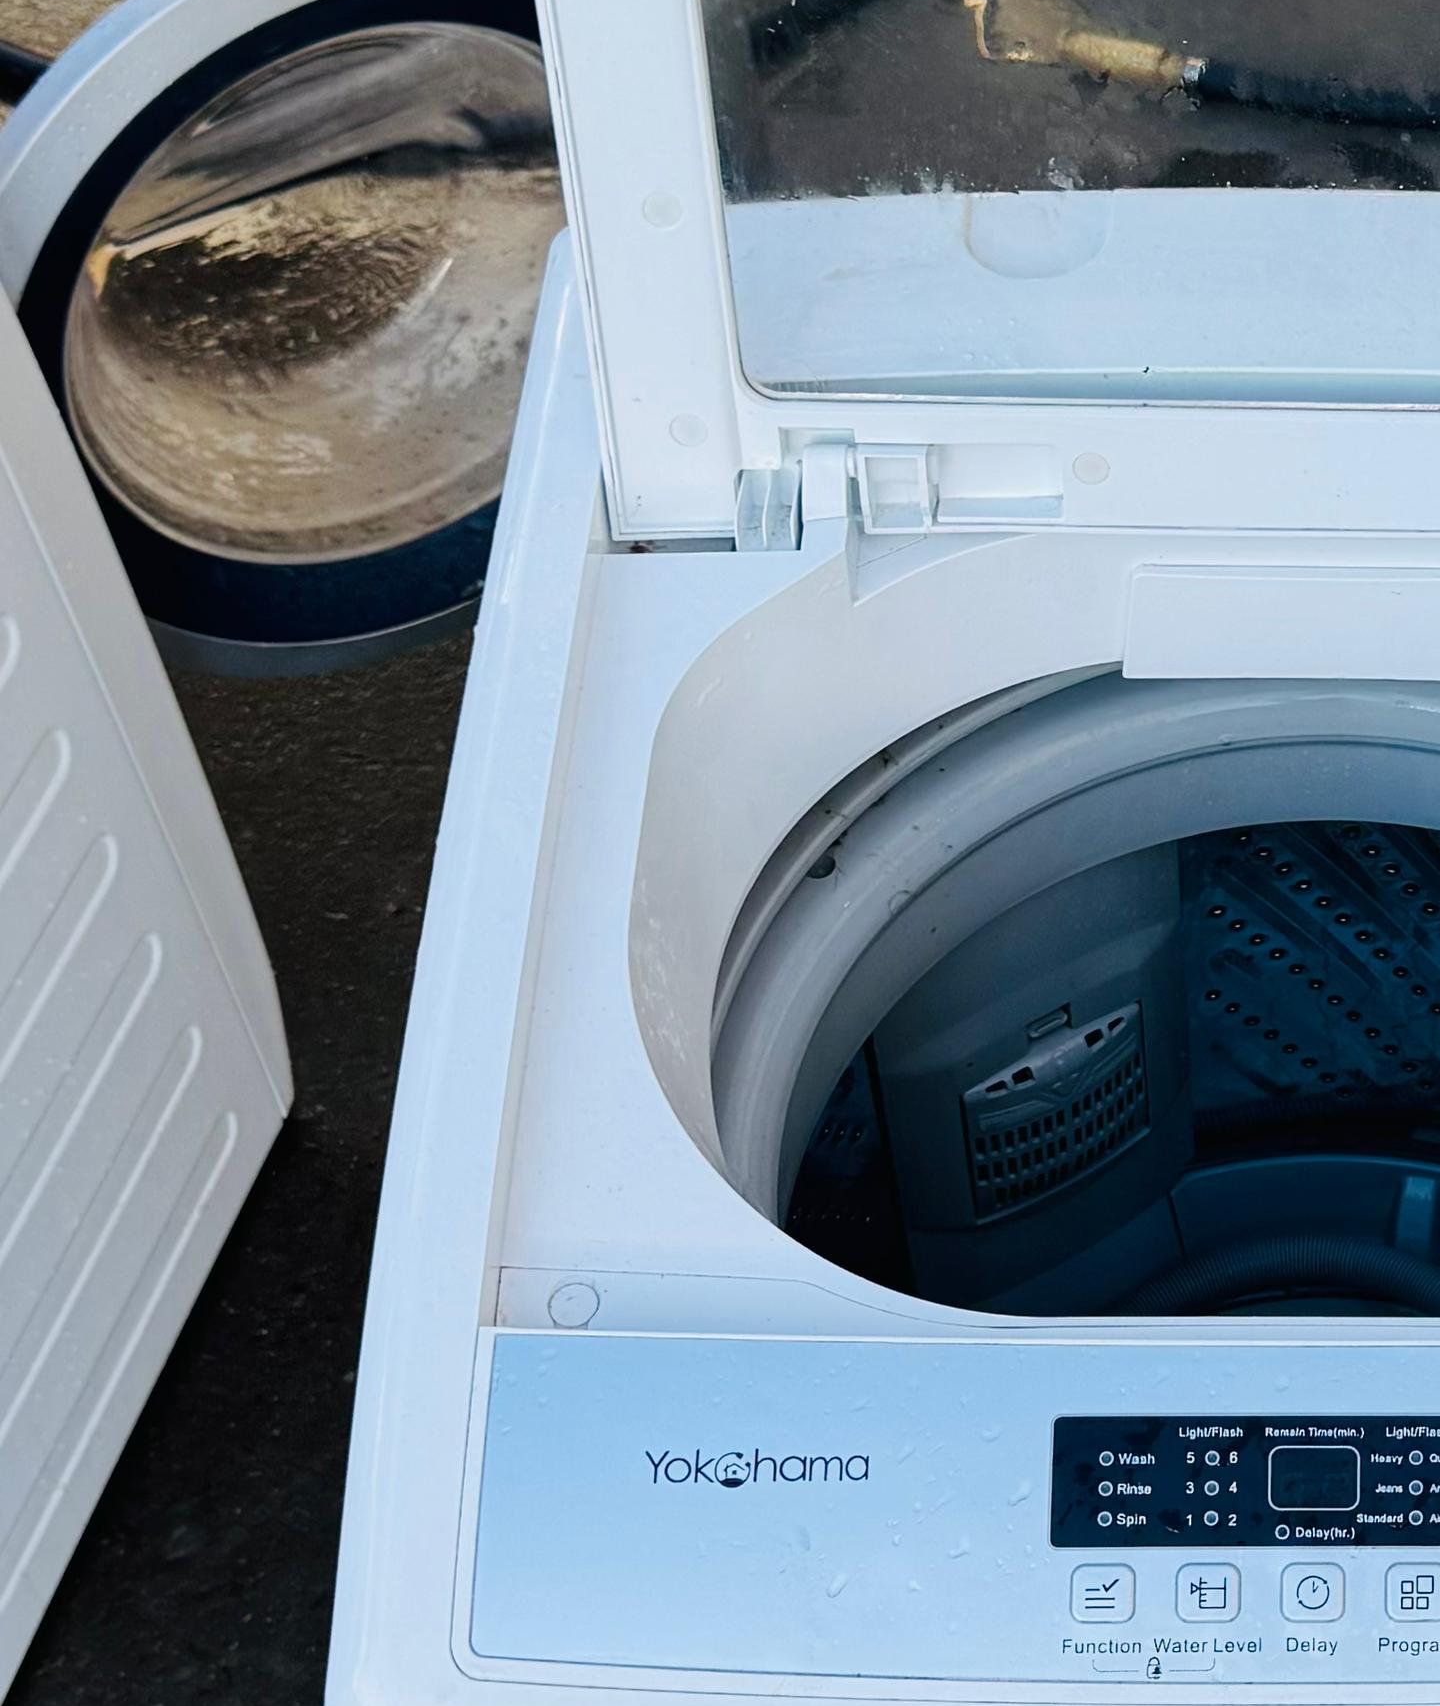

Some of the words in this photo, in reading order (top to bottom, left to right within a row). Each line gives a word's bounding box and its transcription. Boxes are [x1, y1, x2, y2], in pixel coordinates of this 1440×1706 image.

[1179, 1427, 1244, 1439] Light/Flash
[1265, 1427, 1306, 1438] Remain
[1118, 1453, 1156, 1466] Wash
[1186, 1451, 1195, 1464] 5
[1229, 1451, 1238, 1464] 6
[1370, 1453, 1404, 1465] Heavy
[1117, 1483, 1152, 1496] Rinse
[1185, 1481, 1195, 1494] 3
[1228, 1481, 1238, 1494] 4
[1375, 1483, 1404, 1494] Jeans
[1116, 1513, 1147, 1527] Spin
[1185, 1514, 1193, 1526] 1
[1228, 1514, 1237, 1527] 2
[1356, 1513, 1404, 1524] Standard
[1295, 1526, 1356, 1540] Delay(hr.)
[1062, 1638, 1142, 1654] Function
[1153, 1638, 1208, 1653] Water
[1213, 1638, 1262, 1653] Level
[1286, 1637, 1338, 1656] Delay
